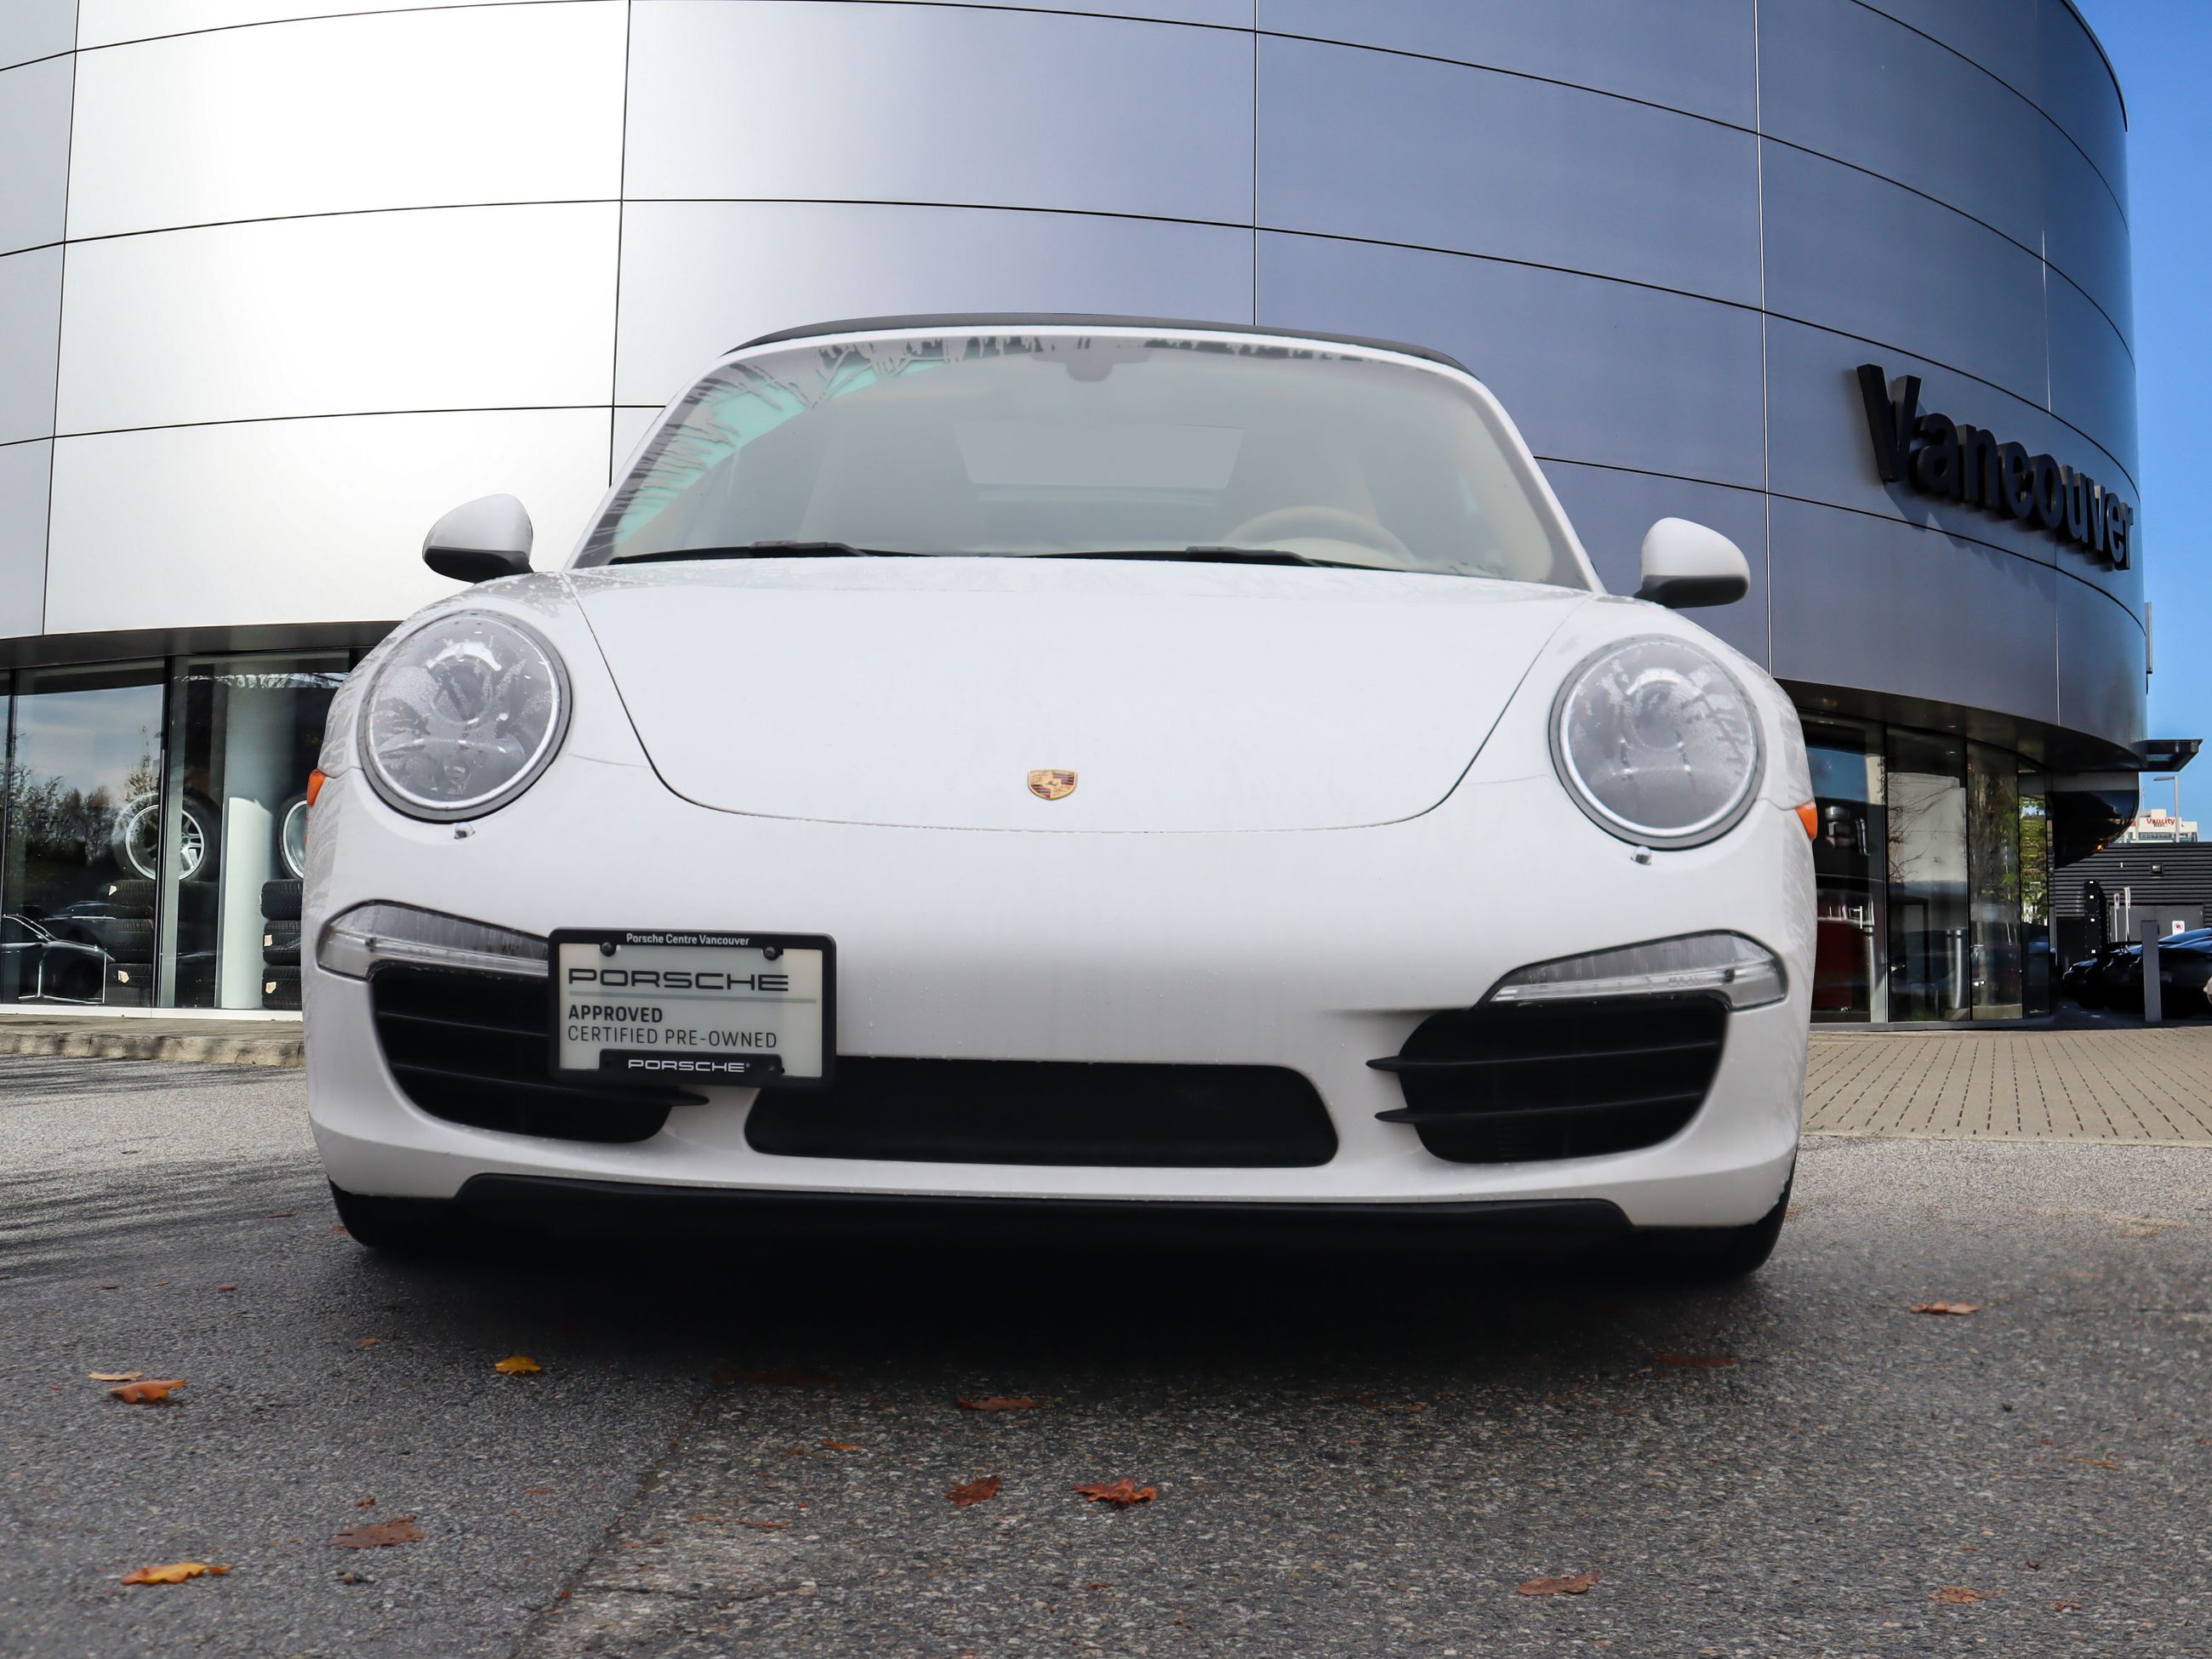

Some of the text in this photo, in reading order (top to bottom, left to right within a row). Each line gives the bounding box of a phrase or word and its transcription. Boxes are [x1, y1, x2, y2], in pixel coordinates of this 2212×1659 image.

[1856, 363, 2134, 571] Vancouver
[626, 932, 750, 946] Porsche Centre Vancouver
[568, 968, 789, 991] PORSCHE
[568, 1004, 663, 1023] APPROVED
[567, 1025, 777, 1048] CERTIFIED PRE-OWNED
[628, 1059, 744, 1073] PORSCHE
